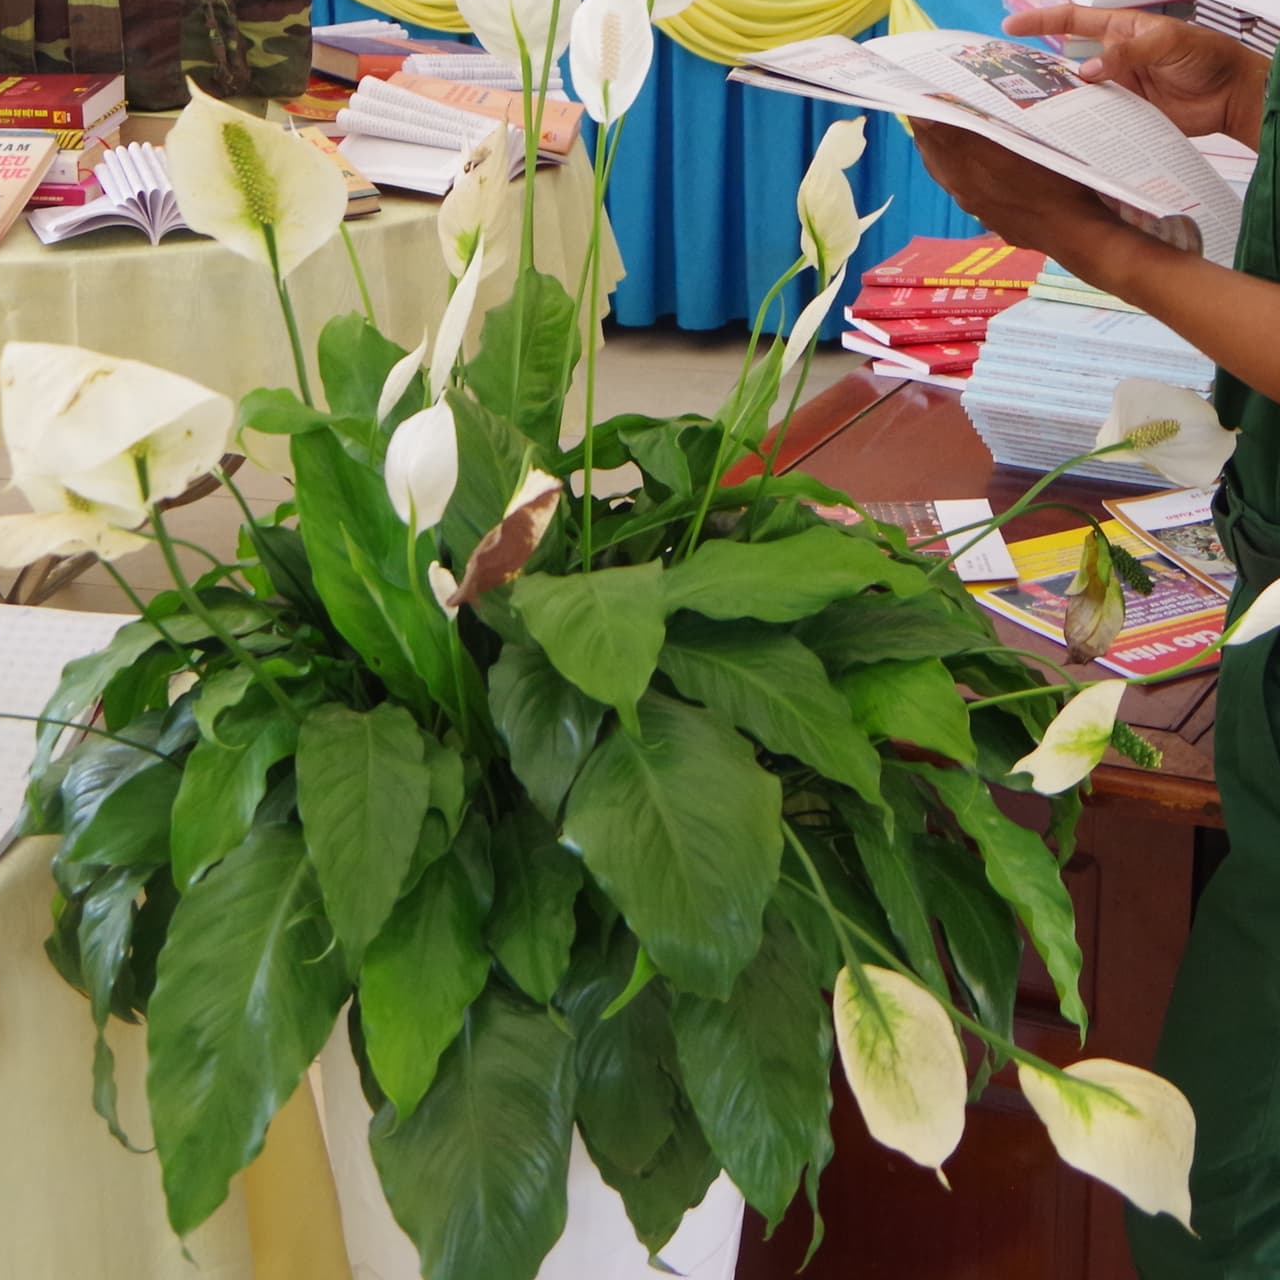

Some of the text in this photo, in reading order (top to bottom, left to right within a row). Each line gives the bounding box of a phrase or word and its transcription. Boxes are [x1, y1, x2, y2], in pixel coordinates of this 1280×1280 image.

[22, 108, 33, 118] VIỆT
[34, 109, 48, 117] NAM
[1112, 641, 1178, 663] VIÊN
